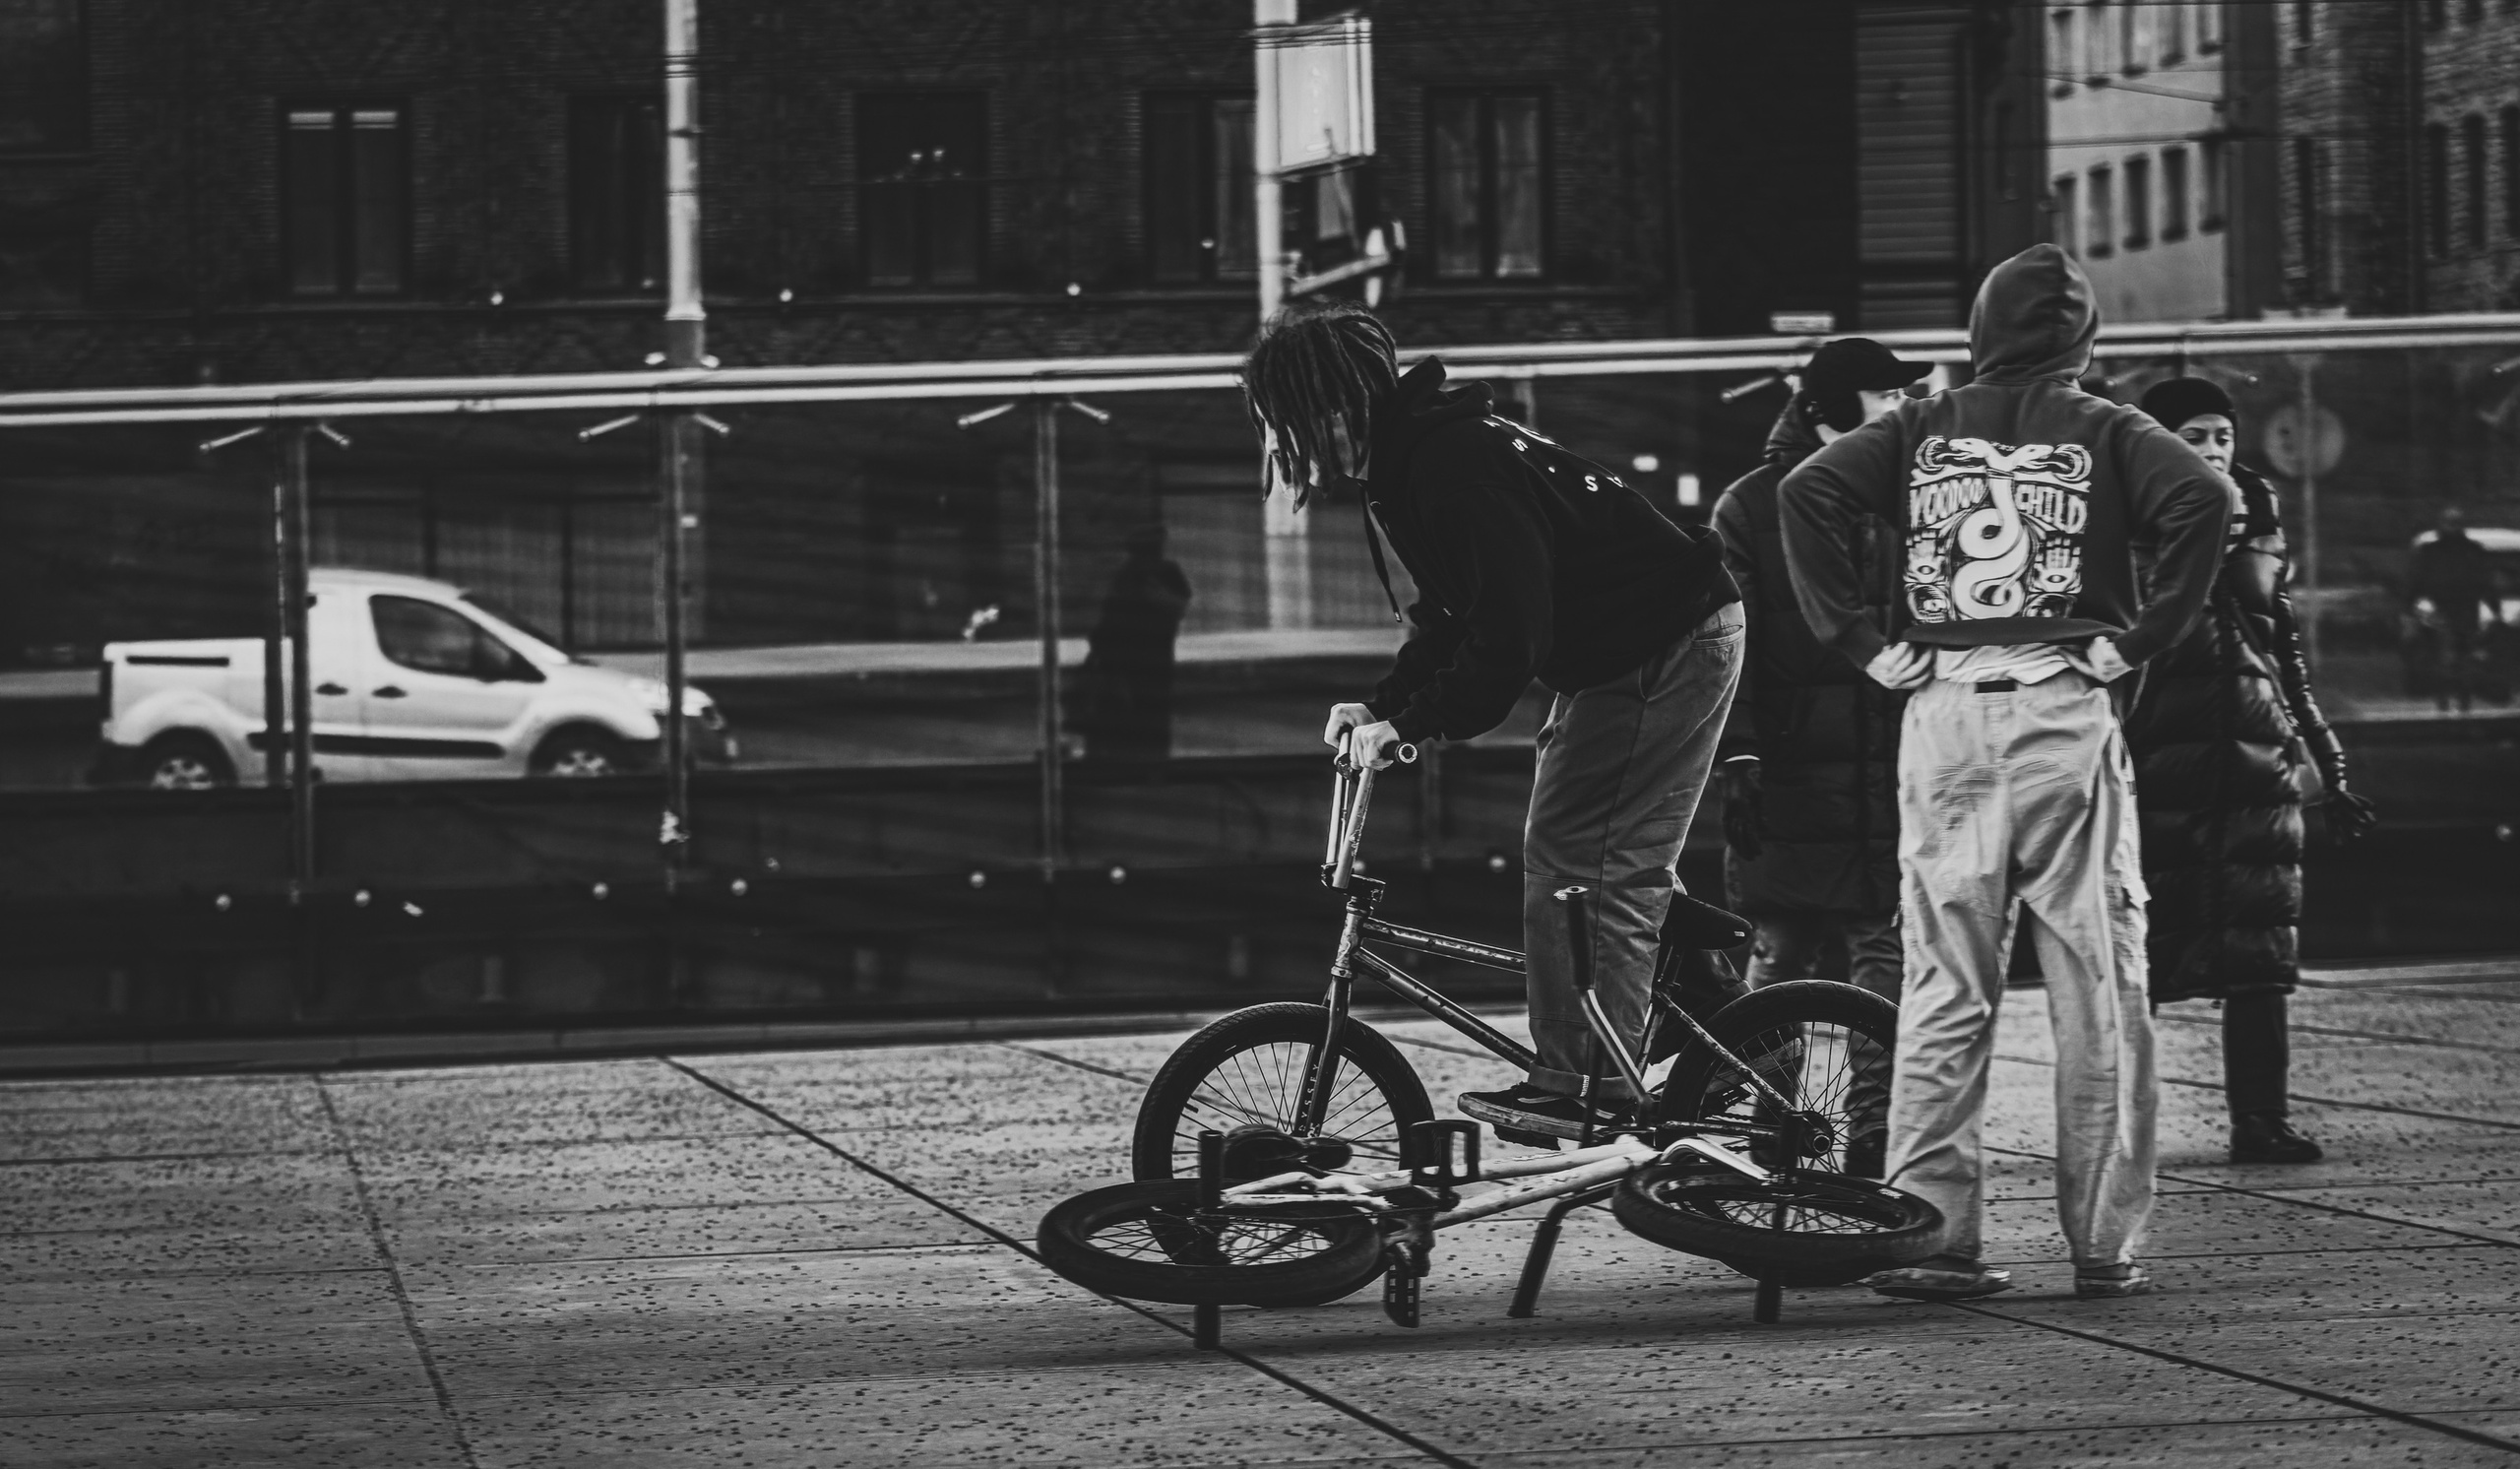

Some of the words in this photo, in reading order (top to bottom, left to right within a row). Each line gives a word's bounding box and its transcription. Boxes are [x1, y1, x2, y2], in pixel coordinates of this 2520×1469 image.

[1909, 477, 1986, 532] VOODOO
[2015, 483, 2088, 535] CHILD
[1297, 1063, 1320, 1133] DYSSEY
